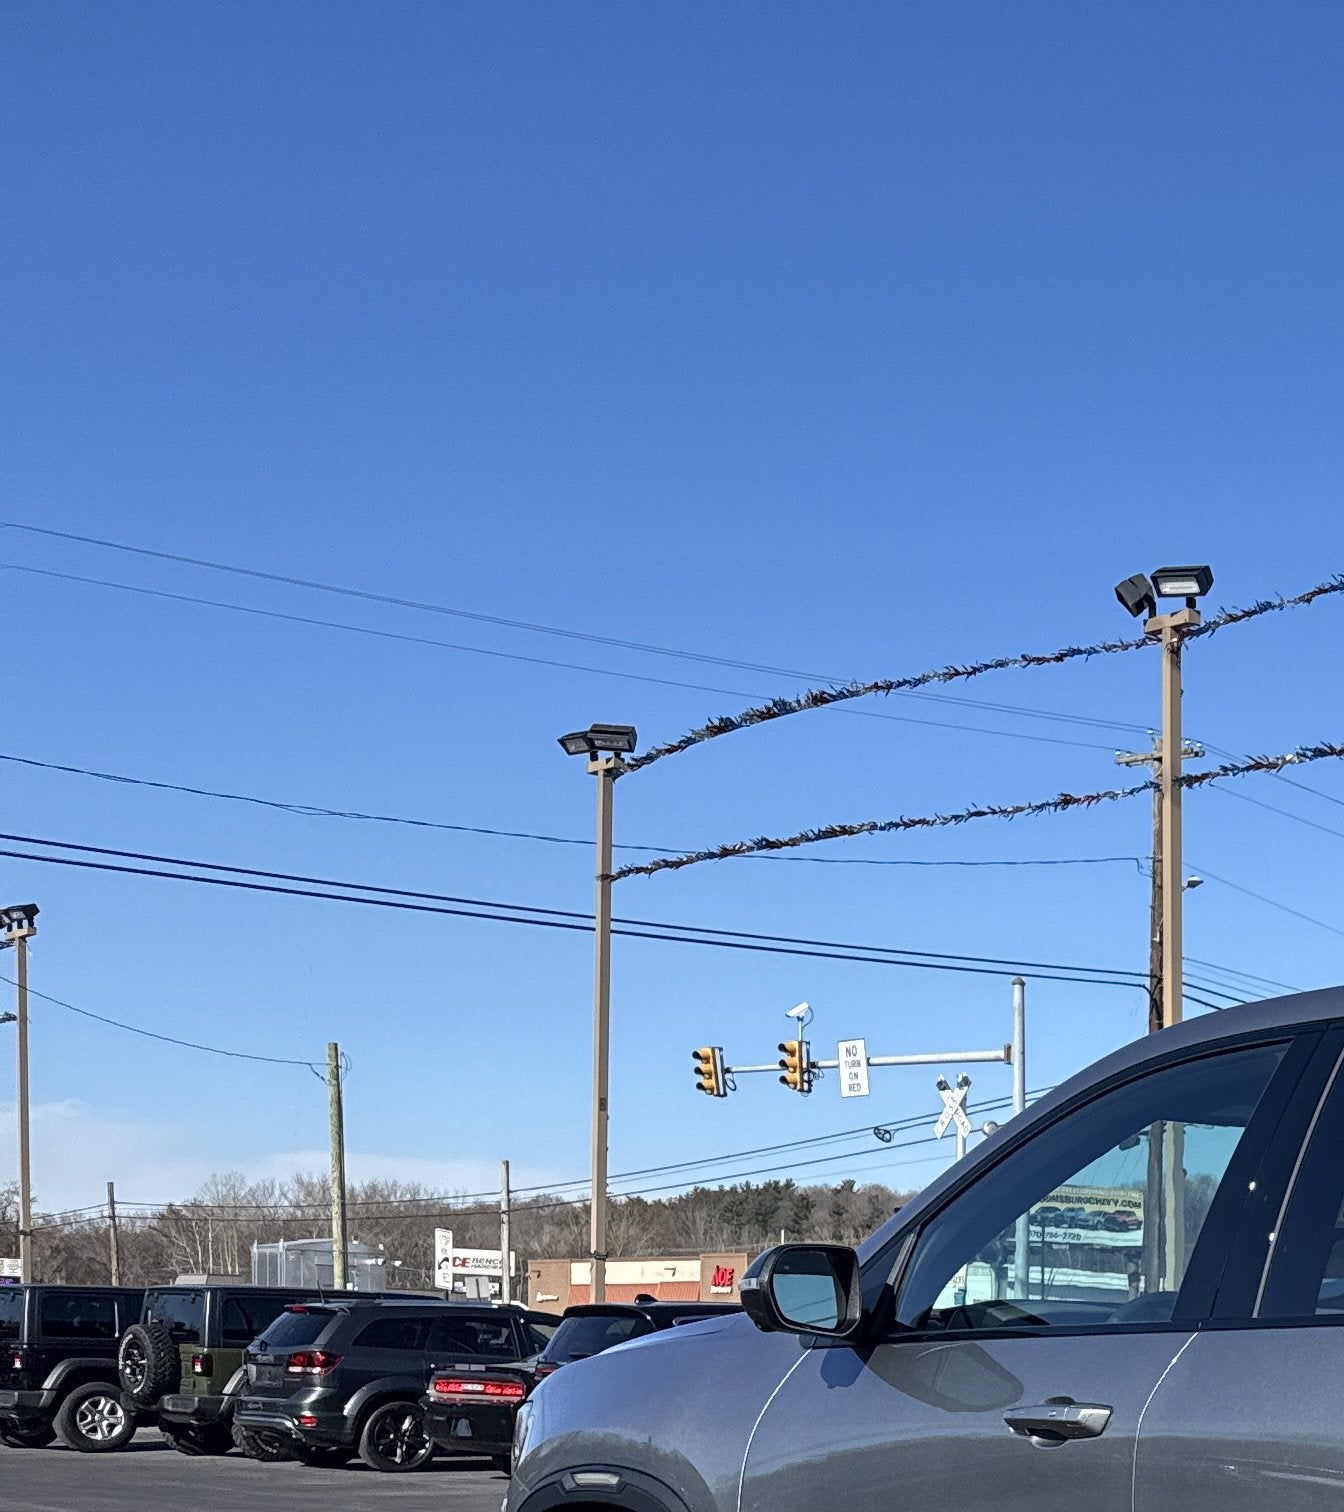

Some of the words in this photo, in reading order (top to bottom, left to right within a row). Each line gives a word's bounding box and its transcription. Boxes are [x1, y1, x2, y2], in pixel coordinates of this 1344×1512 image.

[845, 1045, 858, 1057] NO
[844, 1059, 861, 1068] TURN
[848, 1072, 859, 1081] ON
[848, 1083, 862, 1093] RED
[452, 1256, 471, 1268] CE
[712, 1265, 734, 1286] ACE
